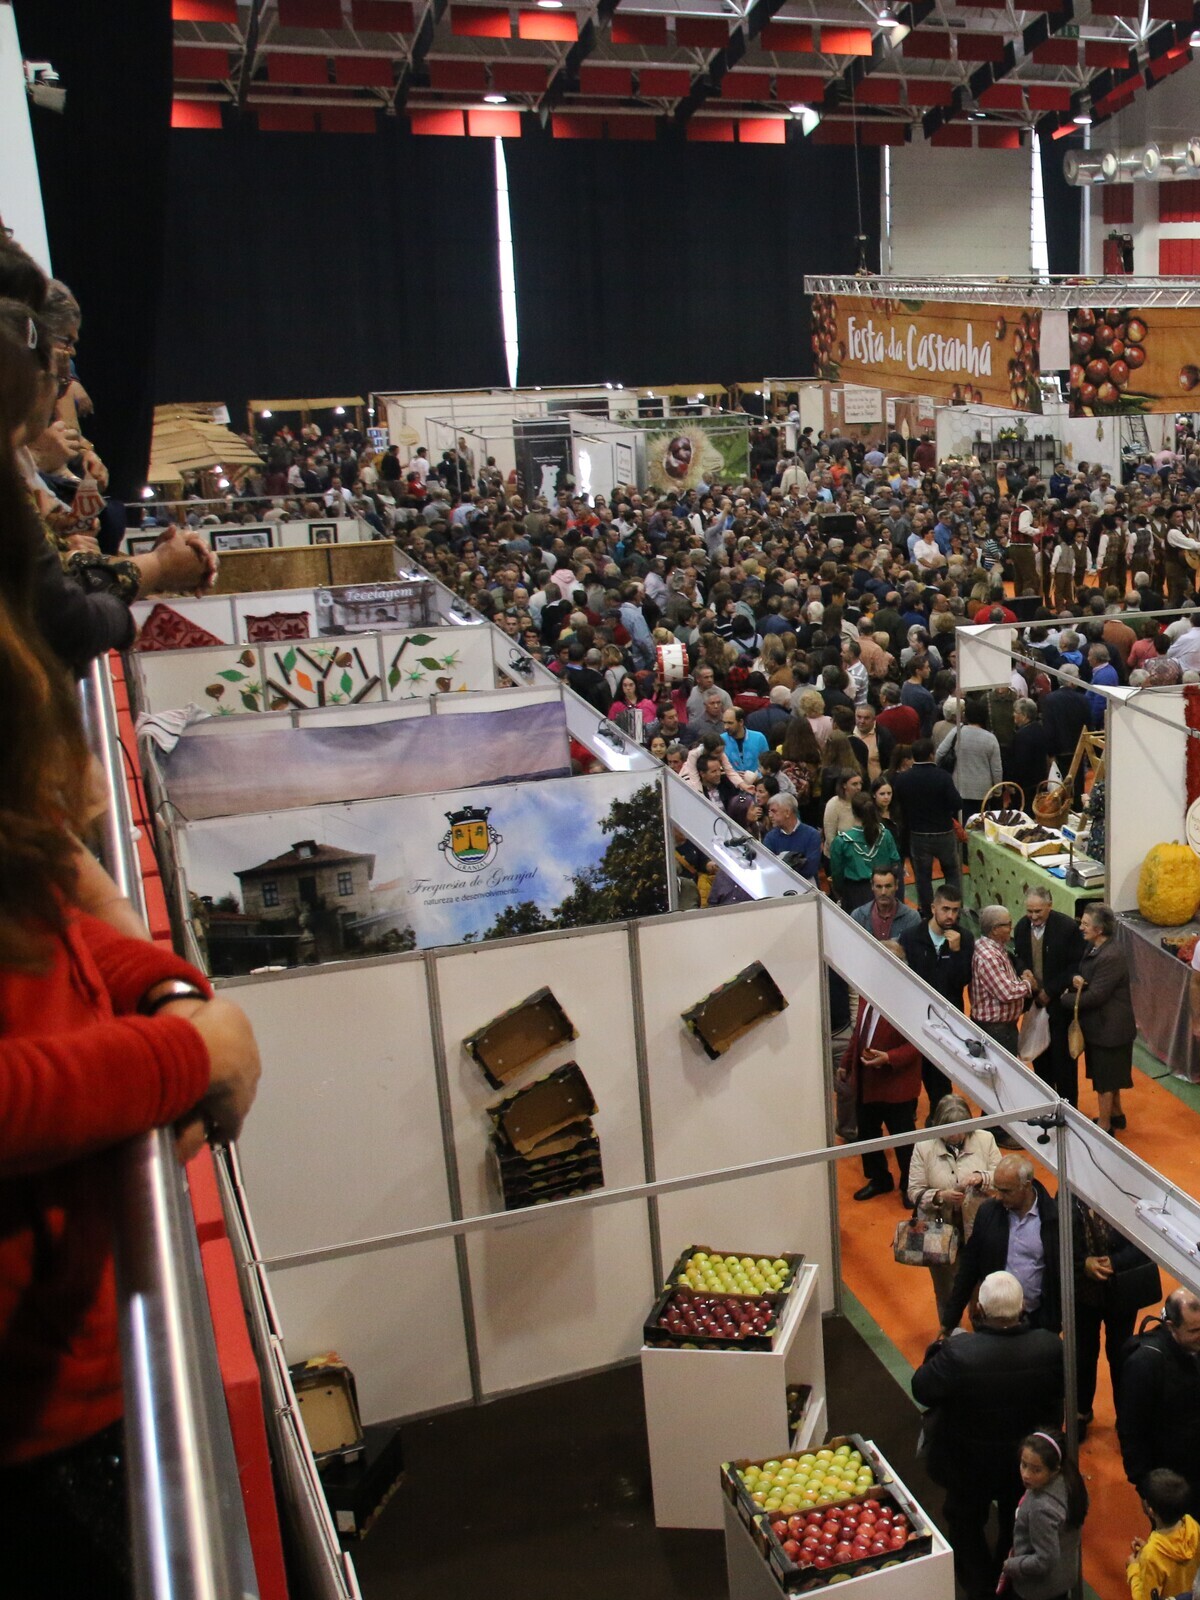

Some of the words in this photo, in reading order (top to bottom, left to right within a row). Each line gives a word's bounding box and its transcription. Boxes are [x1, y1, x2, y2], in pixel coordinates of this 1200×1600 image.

[847, 316, 885, 364] Festa
[888, 327, 903, 361] da
[907, 323, 992, 377] Castanha
[345, 588, 414, 602] Tecelagem
[457, 861, 488, 871] GRANJAL
[407, 879, 466, 898] Freguesia
[486, 867, 538, 889] Granjal
[424, 895, 454, 905] natureza
